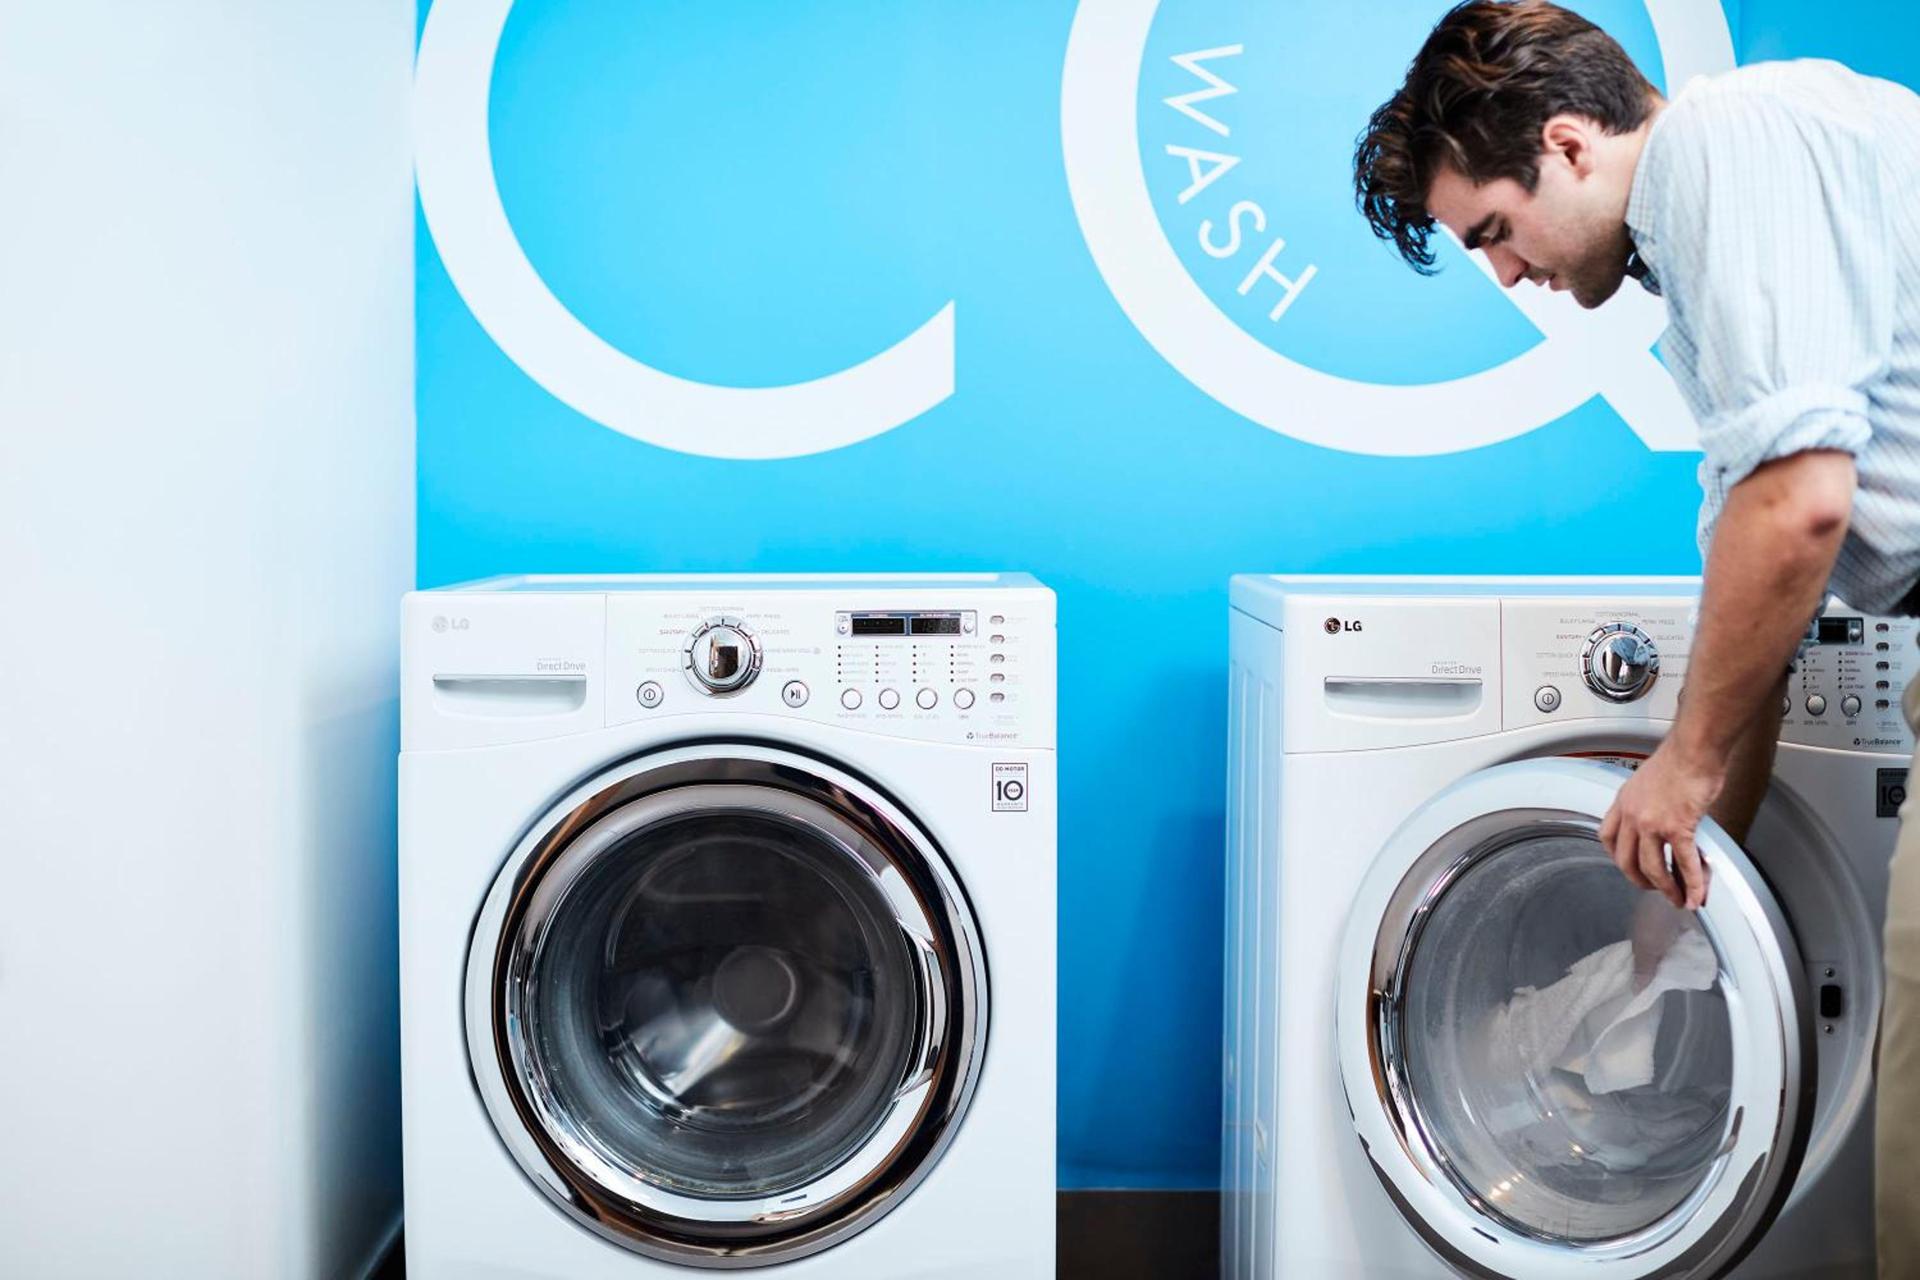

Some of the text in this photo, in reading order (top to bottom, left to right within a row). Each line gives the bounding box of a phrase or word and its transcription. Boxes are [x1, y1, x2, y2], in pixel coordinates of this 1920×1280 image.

[1162, 43, 1319, 322] WASH
[451, 618, 470, 631] LG
[1344, 620, 1363, 632] LG
[996, 780, 1024, 801] 10
